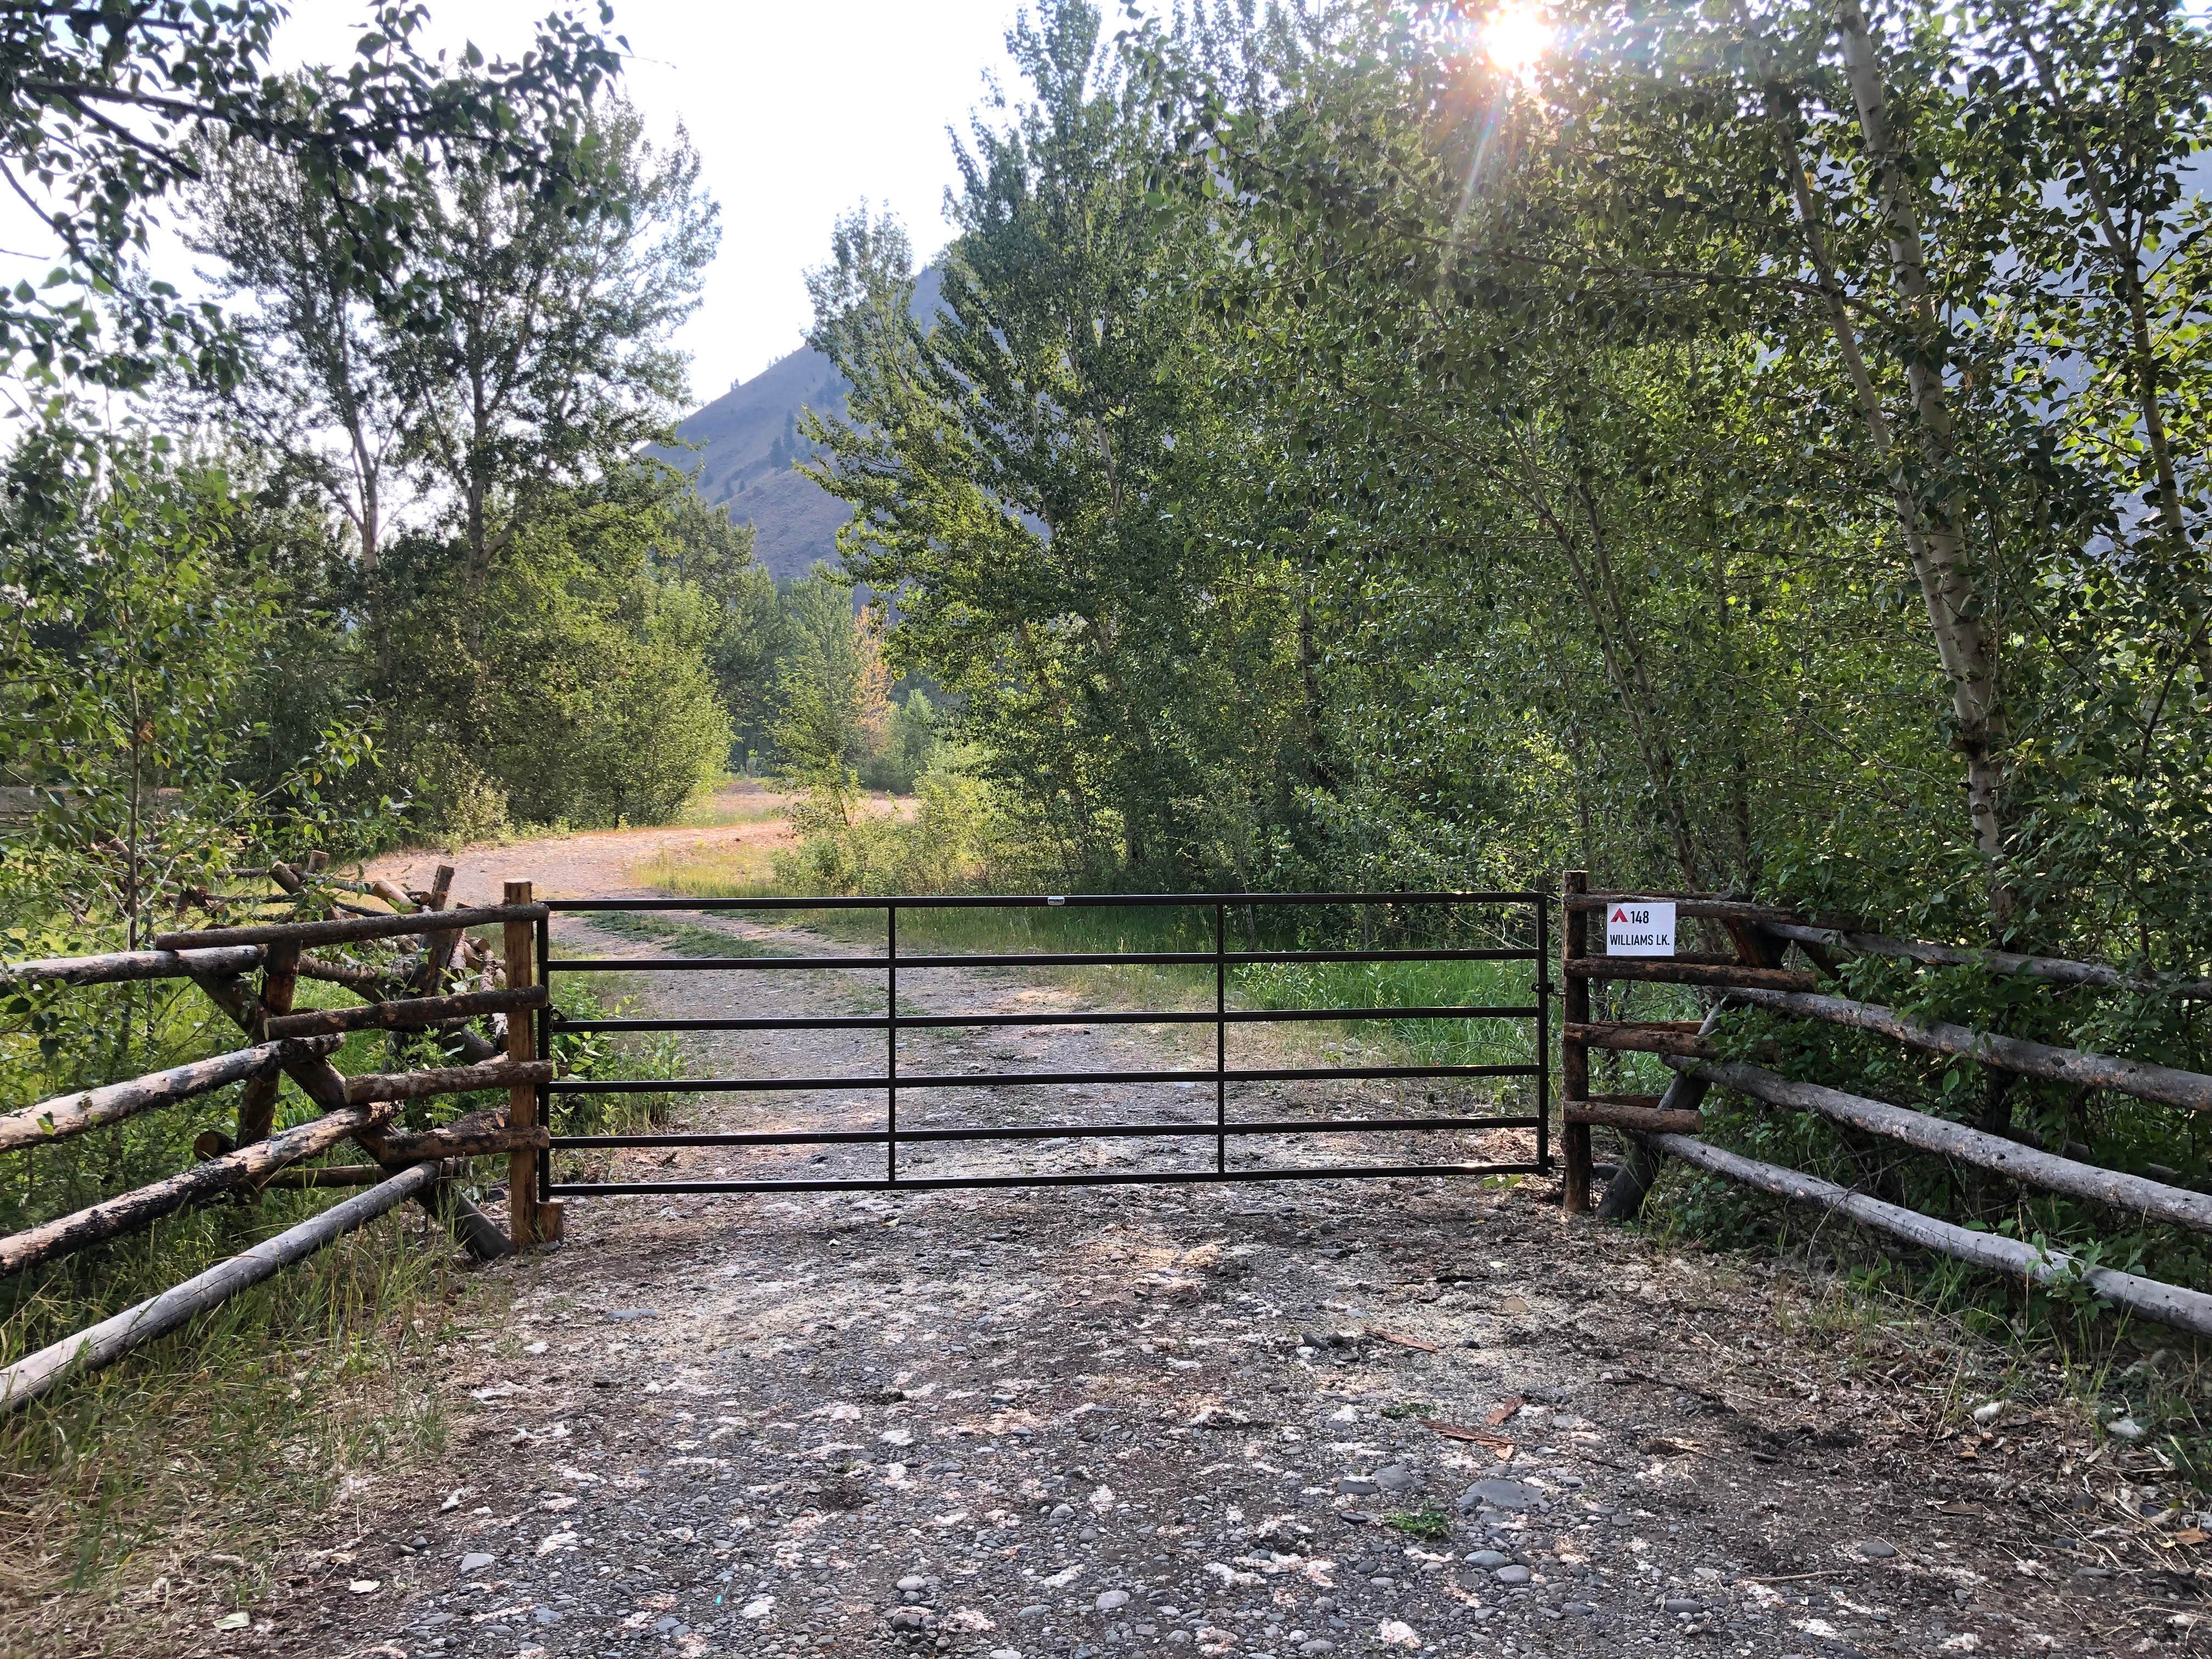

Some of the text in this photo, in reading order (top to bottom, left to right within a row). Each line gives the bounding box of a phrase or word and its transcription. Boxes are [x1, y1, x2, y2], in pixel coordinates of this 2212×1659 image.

[1630, 911, 1649, 924] 148
[1610, 934, 1670, 945] WILLIAMS LK.
